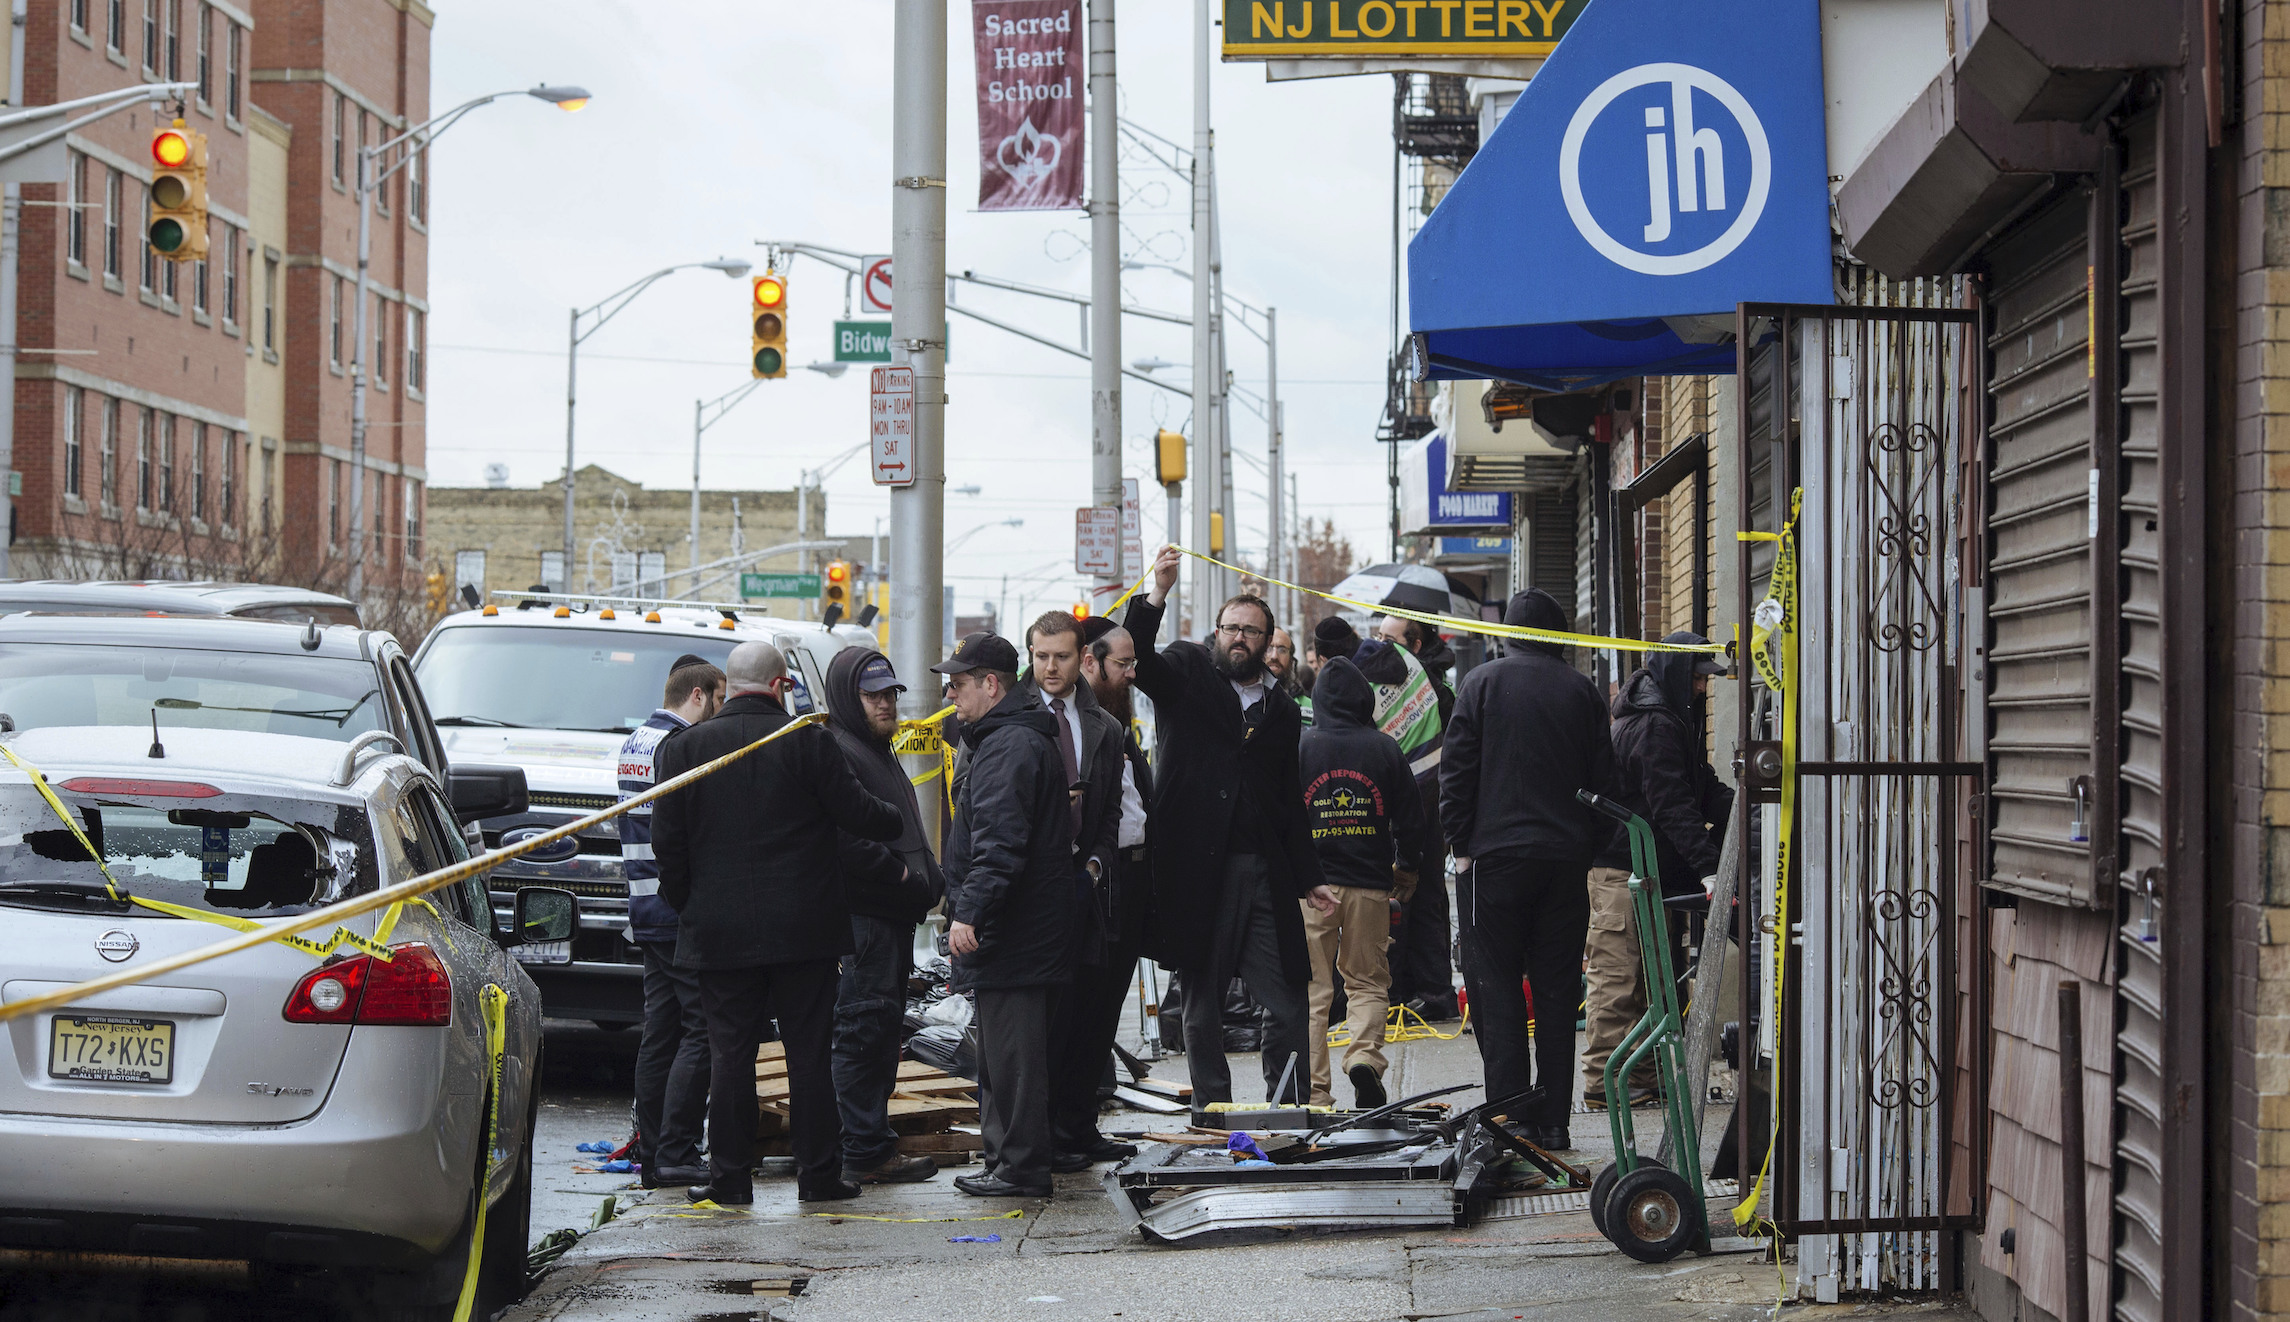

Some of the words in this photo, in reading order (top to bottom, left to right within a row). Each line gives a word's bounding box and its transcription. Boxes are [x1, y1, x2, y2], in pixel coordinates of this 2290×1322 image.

[985, 10, 1071, 37] Sacred
[1252, 1, 1313, 38] NJ
[1330, 0, 1566, 38] LOTTERY
[994, 46, 1066, 70] Heart
[988, 77, 1073, 103] School
[841, 330, 892, 354] Bidw
[873, 370, 886, 393] NO
[887, 374, 910, 387] PARKING
[874, 399, 887, 415] 9AM
[894, 398, 911, 415] 10AM
[874, 420, 889, 436] MON
[893, 419, 910, 435] THRU
[884, 440, 898, 456] SAT
[1439, 494, 1463, 517] FOOD
[1077, 509, 1092, 523] NO
[1080, 538, 1095, 547] MON
[1090, 550, 1103, 559] SAT
[1330, 768, 1374, 788] REPONSE
[1313, 798, 1332, 807] GOLD
[1320, 810, 1368, 818] RESTORATION
[99, 941, 133, 950] NISSAN
[81, 1021, 108, 1032] New
[109, 1023, 143, 1035] Jersey
[60, 1033, 103, 1064] T72
[119, 1036, 164, 1067] KXS
[80, 1066, 112, 1075] Garden
[116, 1068, 140, 1076] State
